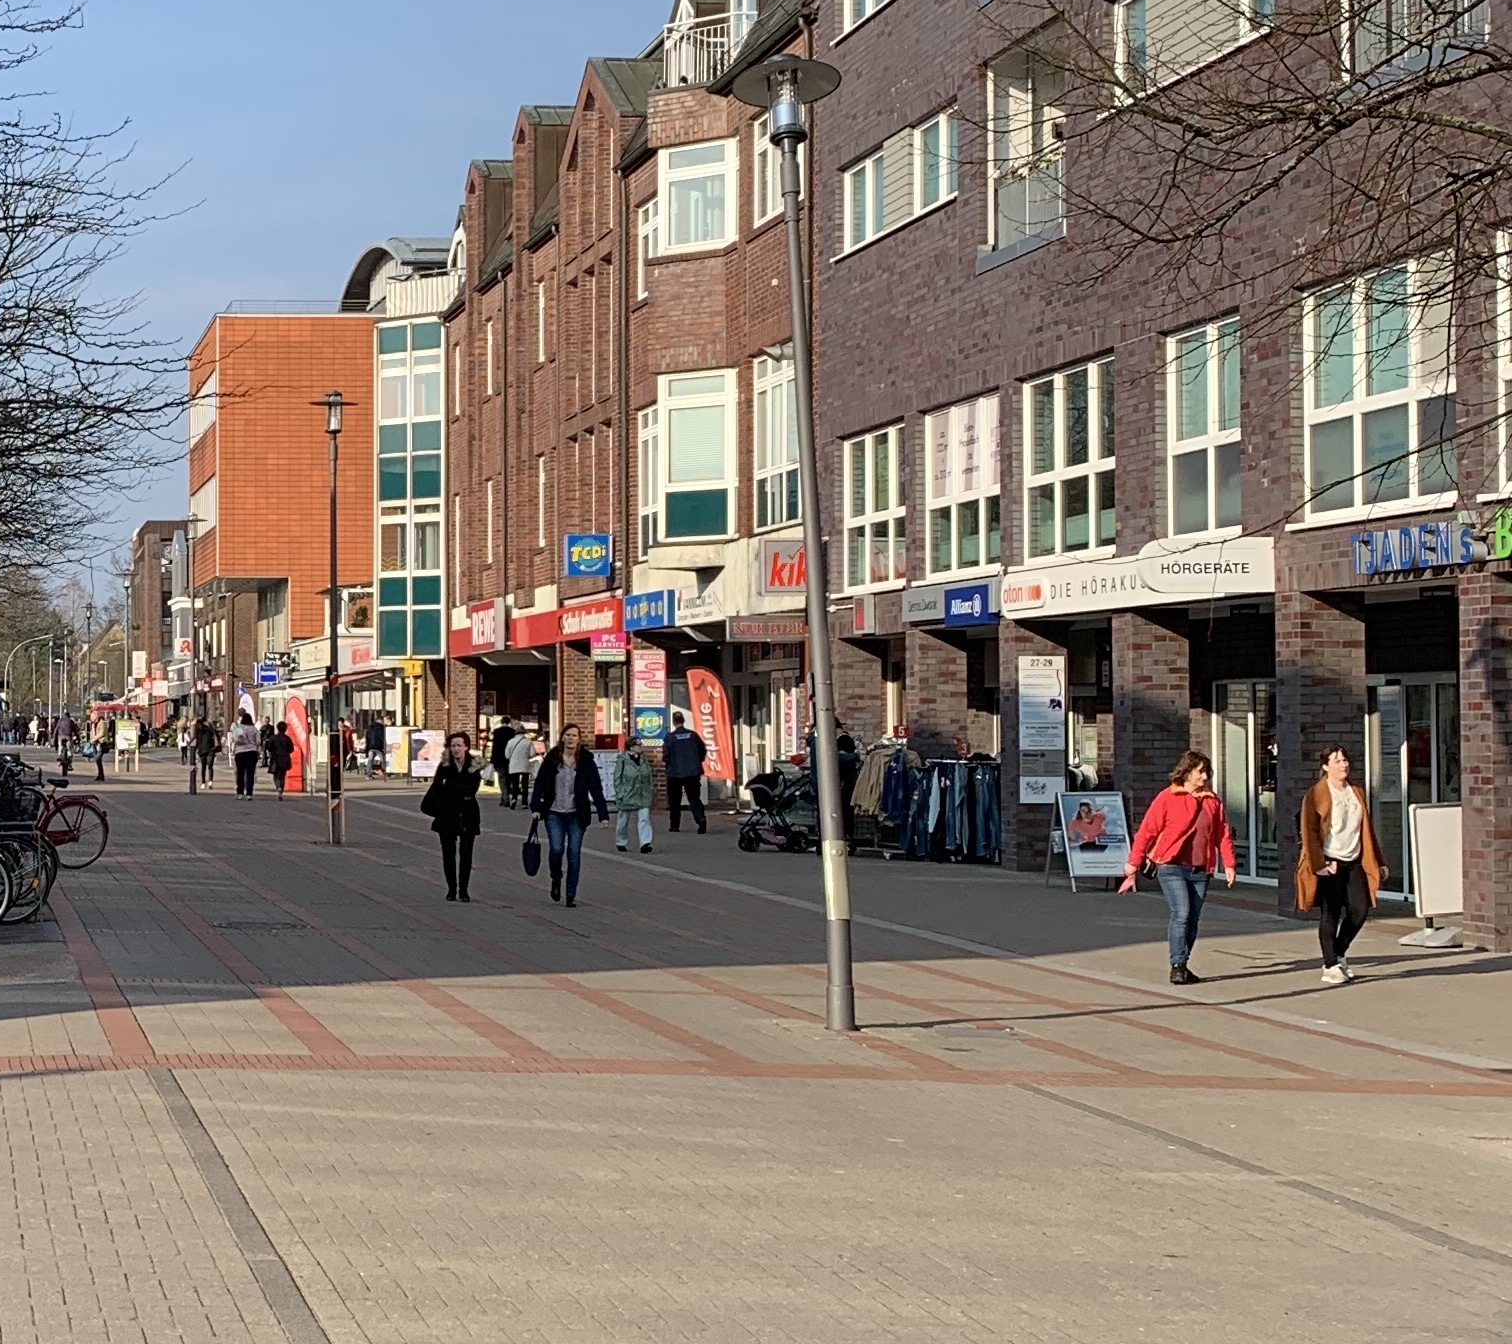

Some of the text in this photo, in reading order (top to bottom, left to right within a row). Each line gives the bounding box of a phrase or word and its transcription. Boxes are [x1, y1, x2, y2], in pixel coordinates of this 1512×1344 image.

[1160, 560, 1250, 575] HÖRGERÄTE
[1003, 587, 1024, 604] oton
[1050, 582, 1072, 599] DIE
[950, 598, 973, 615] Allianz
[472, 608, 495, 645] REWE
[601, 634, 617, 642] PC
[1031, 659, 1053, 667] 27-29
